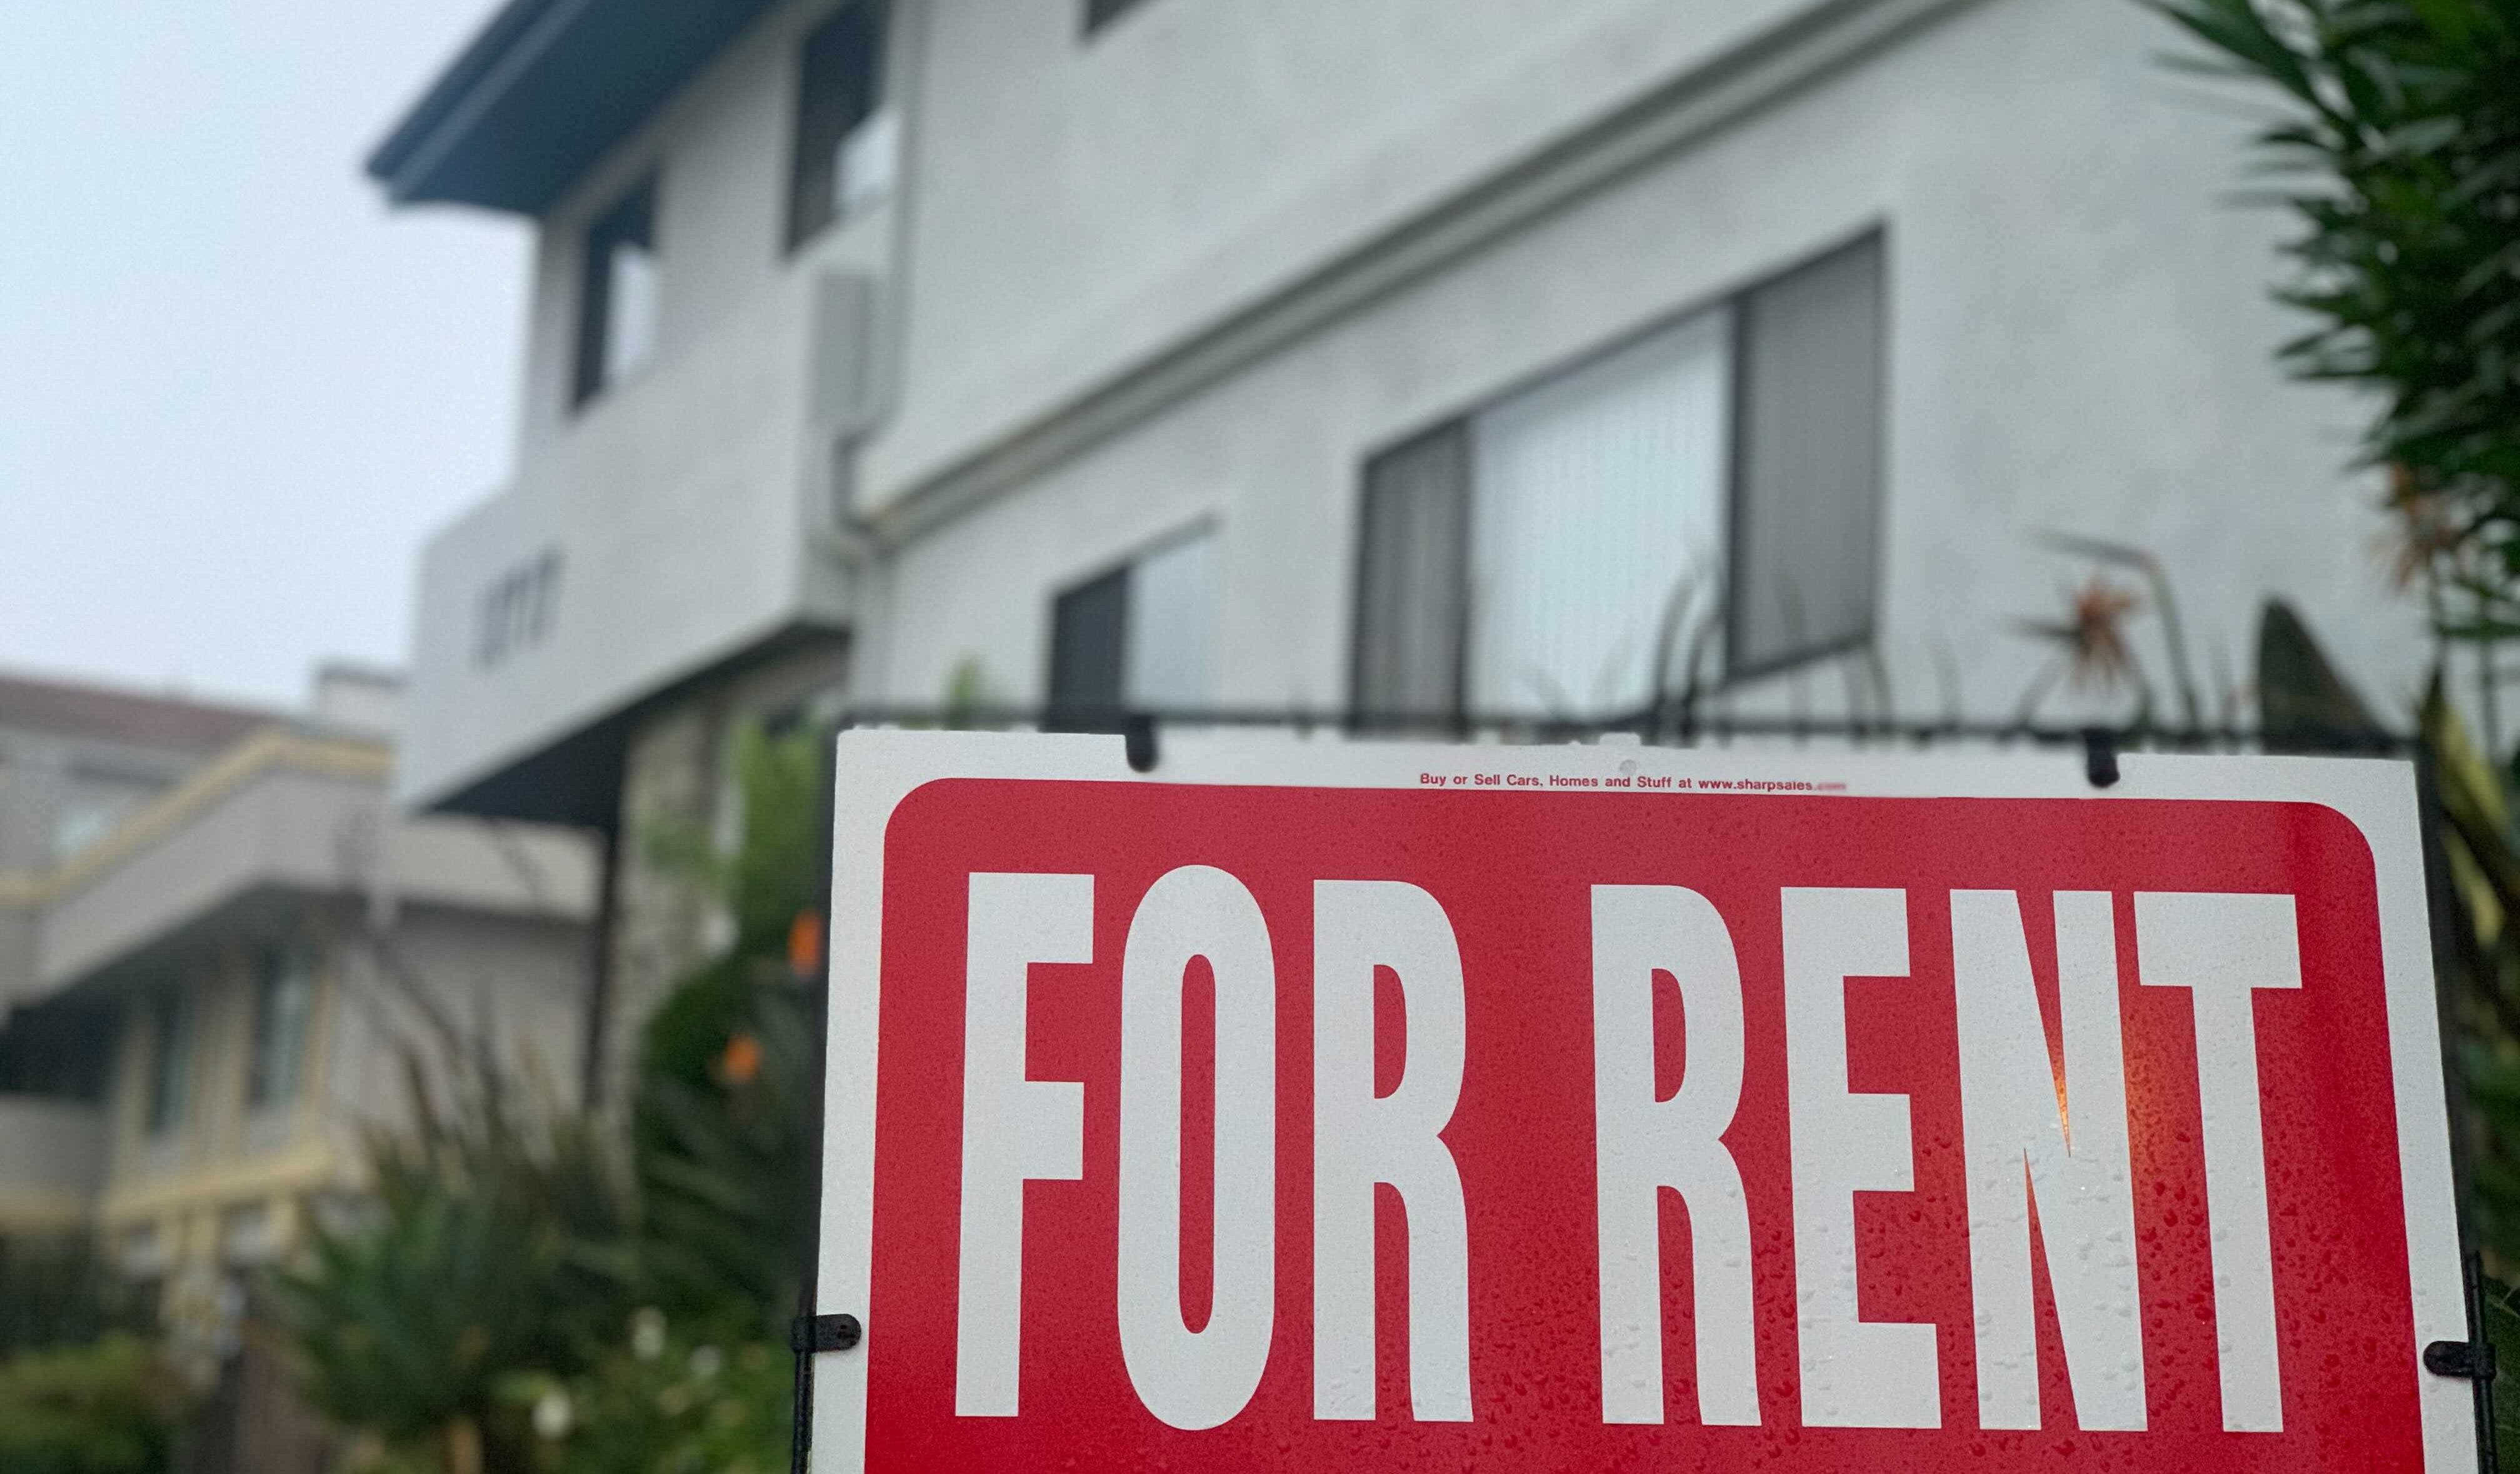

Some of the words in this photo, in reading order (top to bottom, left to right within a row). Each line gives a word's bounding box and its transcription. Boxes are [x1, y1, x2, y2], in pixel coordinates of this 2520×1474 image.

[1421, 773, 1446, 786] Buy
[1453, 776, 1467, 785] or
[1474, 774, 1500, 785] Sell
[1507, 775, 1543, 786] Cars,
[1550, 776, 1598, 786] Homes
[1605, 777, 1631, 787] and
[1638, 776, 1671, 788] Stuff
[1678, 779, 1692, 788] at
[1698, 779, 1846, 793] www.sharpsales.
[956, 865, 1474, 1430] FOR
[1591, 885, 2302, 1432] RENT
